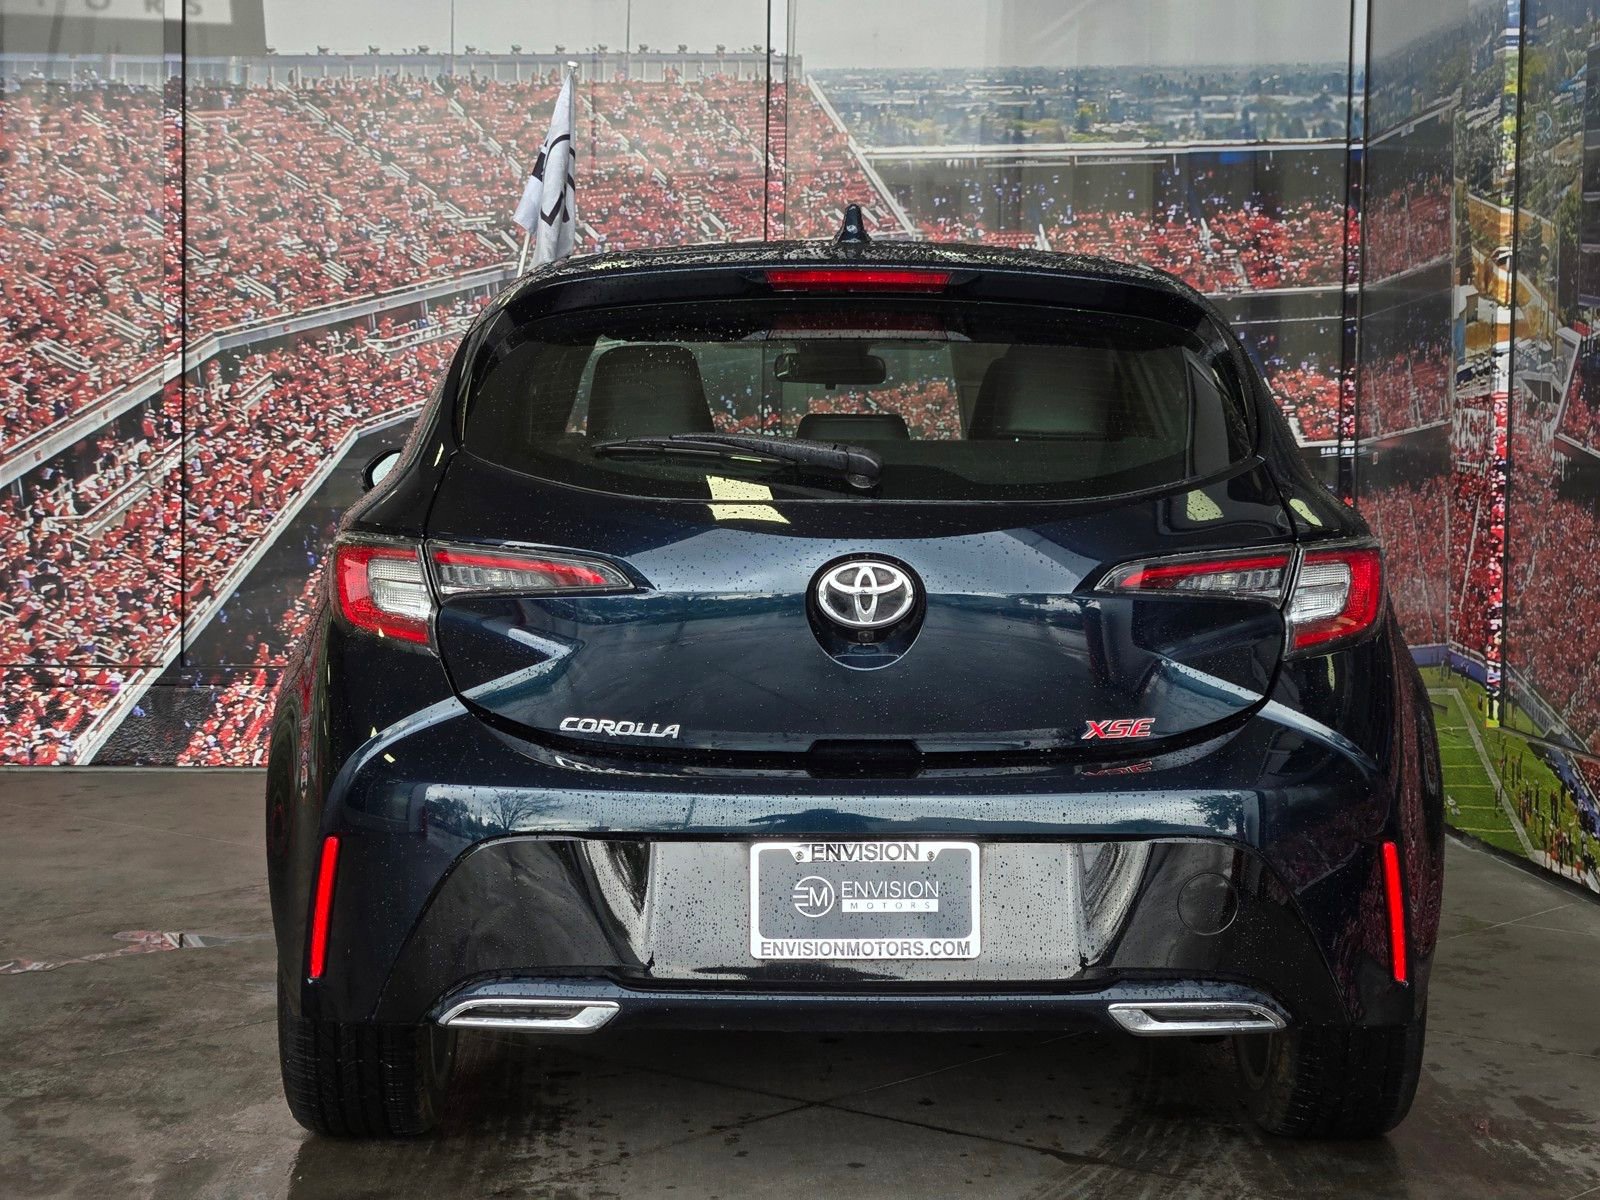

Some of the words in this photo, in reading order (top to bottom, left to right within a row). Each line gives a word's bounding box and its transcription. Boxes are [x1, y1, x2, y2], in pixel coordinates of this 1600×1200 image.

[559, 717, 680, 738] COROLLA
[1081, 717, 1156, 740] XSE
[811, 843, 920, 861] ENVISION
[841, 881, 939, 898] ENVISION
[850, 902, 931, 910] MOTORS
[760, 941, 971, 956] ENVISIONMOTORS.COM
